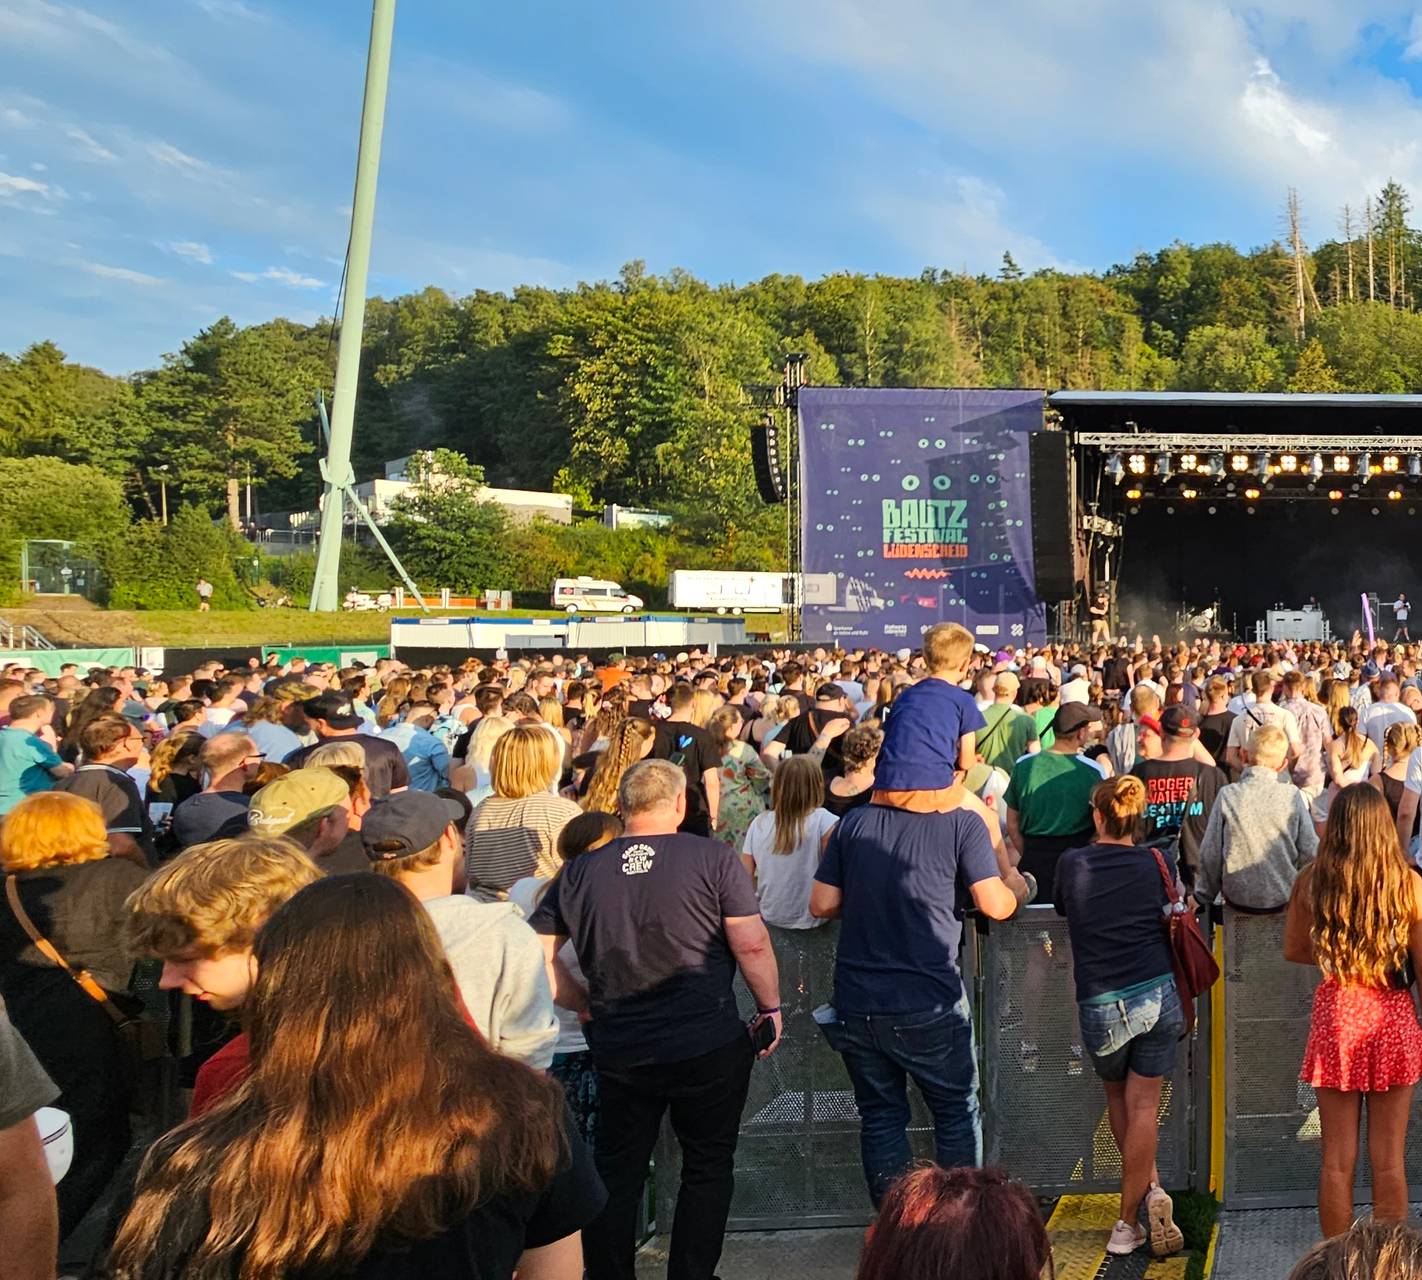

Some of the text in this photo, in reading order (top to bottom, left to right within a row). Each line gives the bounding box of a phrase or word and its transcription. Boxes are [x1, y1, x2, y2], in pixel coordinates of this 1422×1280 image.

[882, 499, 968, 528] BAUTZ
[882, 528, 968, 543] FESTIVAL
[1147, 776, 1194, 791] ROGER
[621, 859, 653, 873] CREW
